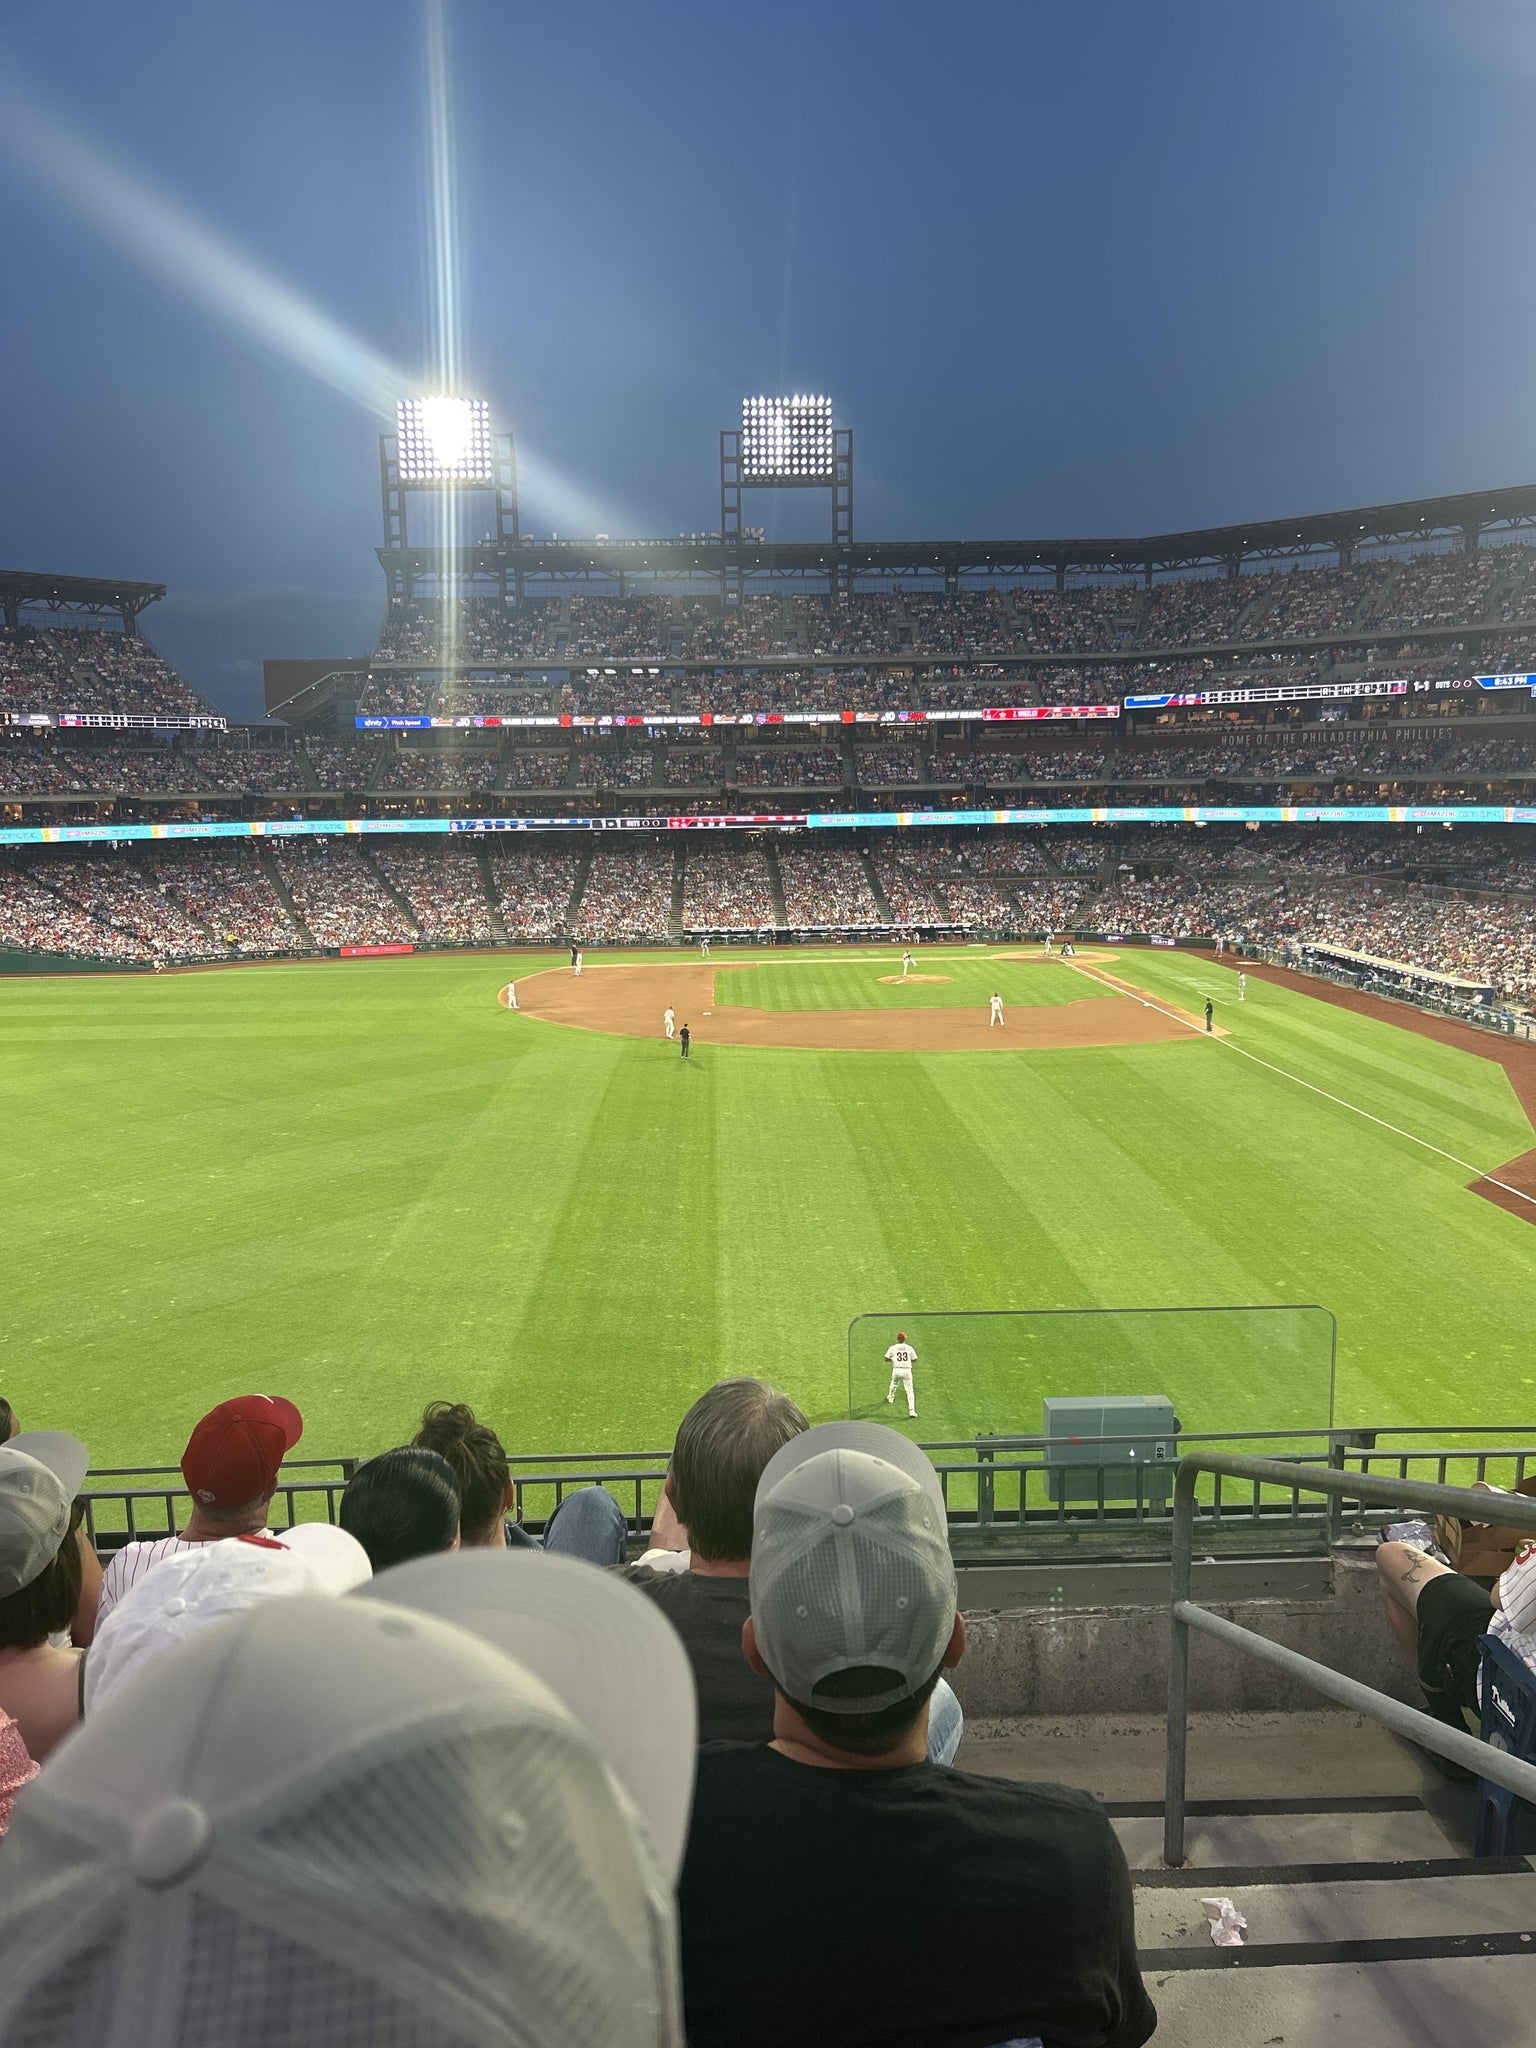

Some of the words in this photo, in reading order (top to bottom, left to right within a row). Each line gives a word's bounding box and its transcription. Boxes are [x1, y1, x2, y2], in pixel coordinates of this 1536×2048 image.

[1436, 681, 1450, 689] OUTS
[1514, 676, 1528, 684] PM
[1221, 734, 1250, 746] HOME
[1276, 733, 1296, 744] THE
[1302, 730, 1388, 744] PHILADELPHIA
[1395, 727, 1453, 741] PHILLIES
[896, 1352, 908, 1362] 33
[1156, 1447, 1164, 1458] 68
